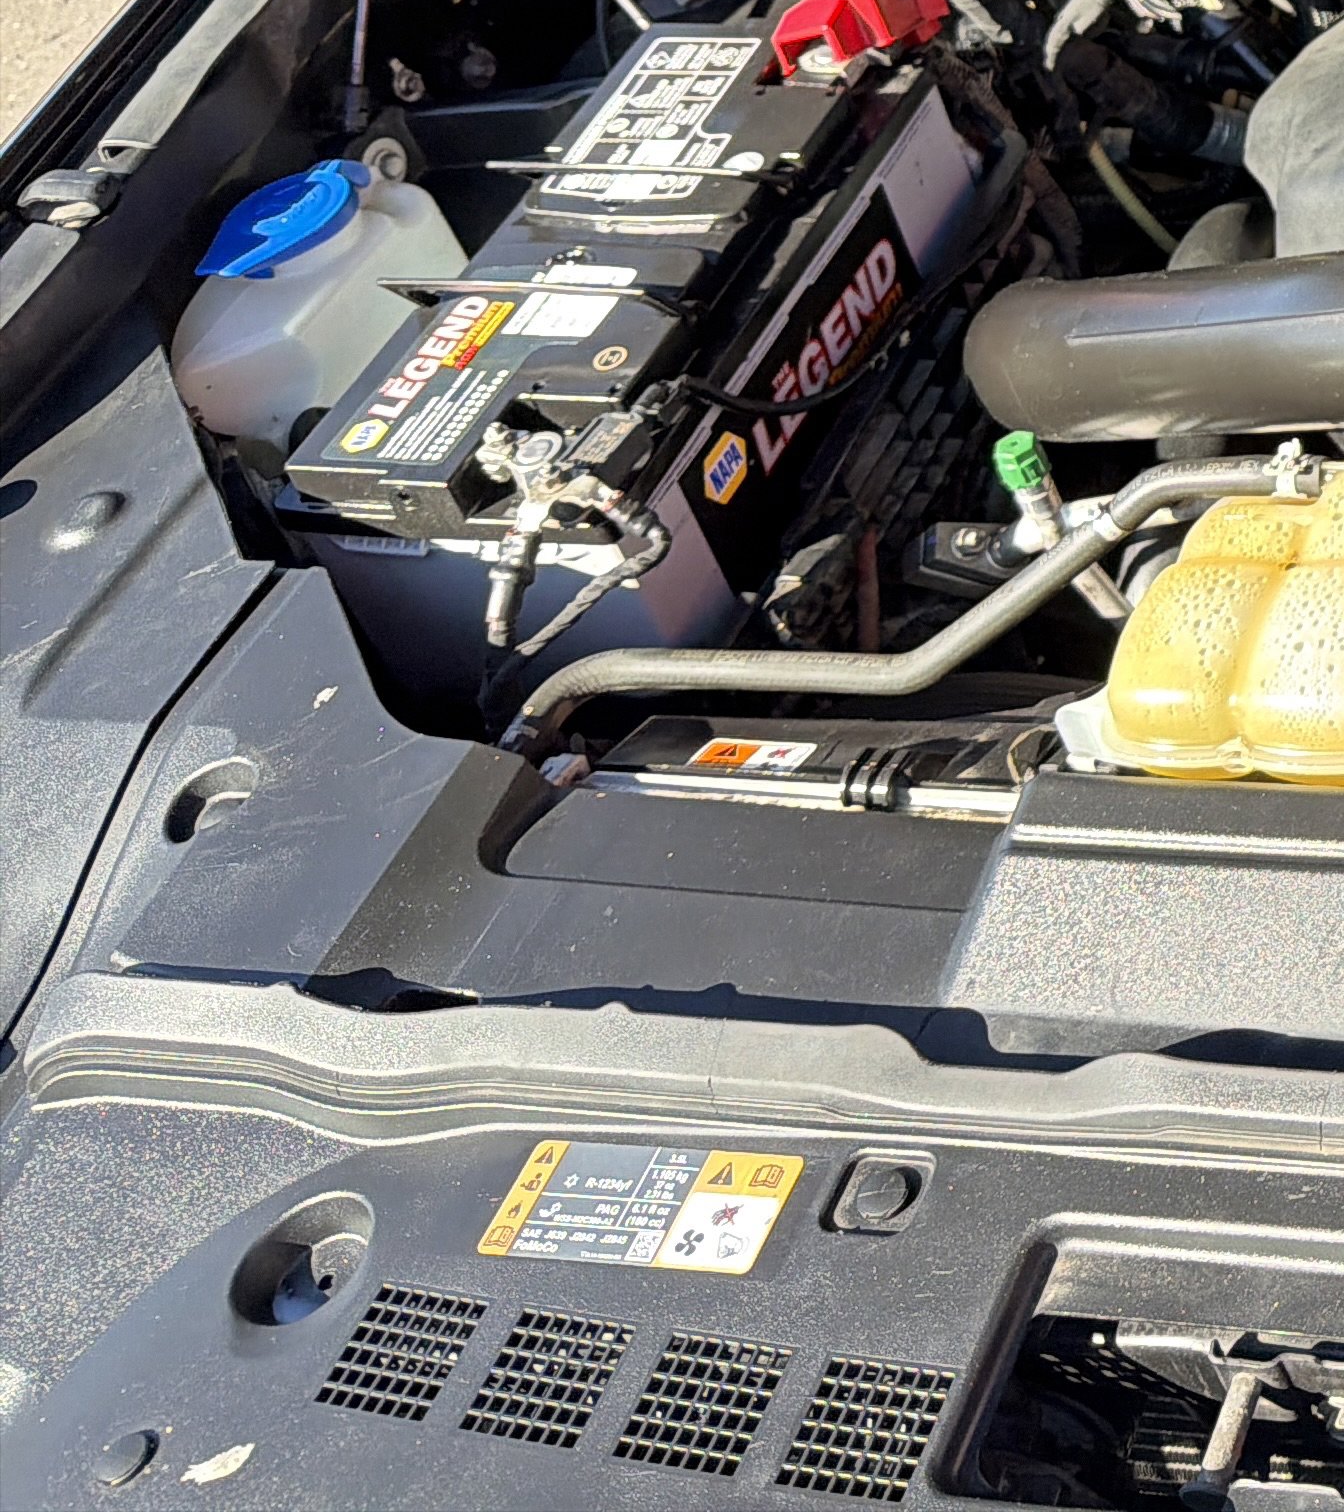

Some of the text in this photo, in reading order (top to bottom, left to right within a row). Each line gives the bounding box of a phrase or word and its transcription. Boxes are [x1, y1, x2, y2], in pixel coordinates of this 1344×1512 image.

[440, 301, 505, 367] Premium
[367, 296, 489, 419] LEGEND
[752, 238, 896, 477] LEGEND
[709, 441, 743, 495] NAPA
[584, 1176, 634, 1192] R-1234yf
[594, 1203, 622, 1216] PAG
[511, 1238, 559, 1254] FoMoCo
[520, 1227, 543, 1239] SAE
